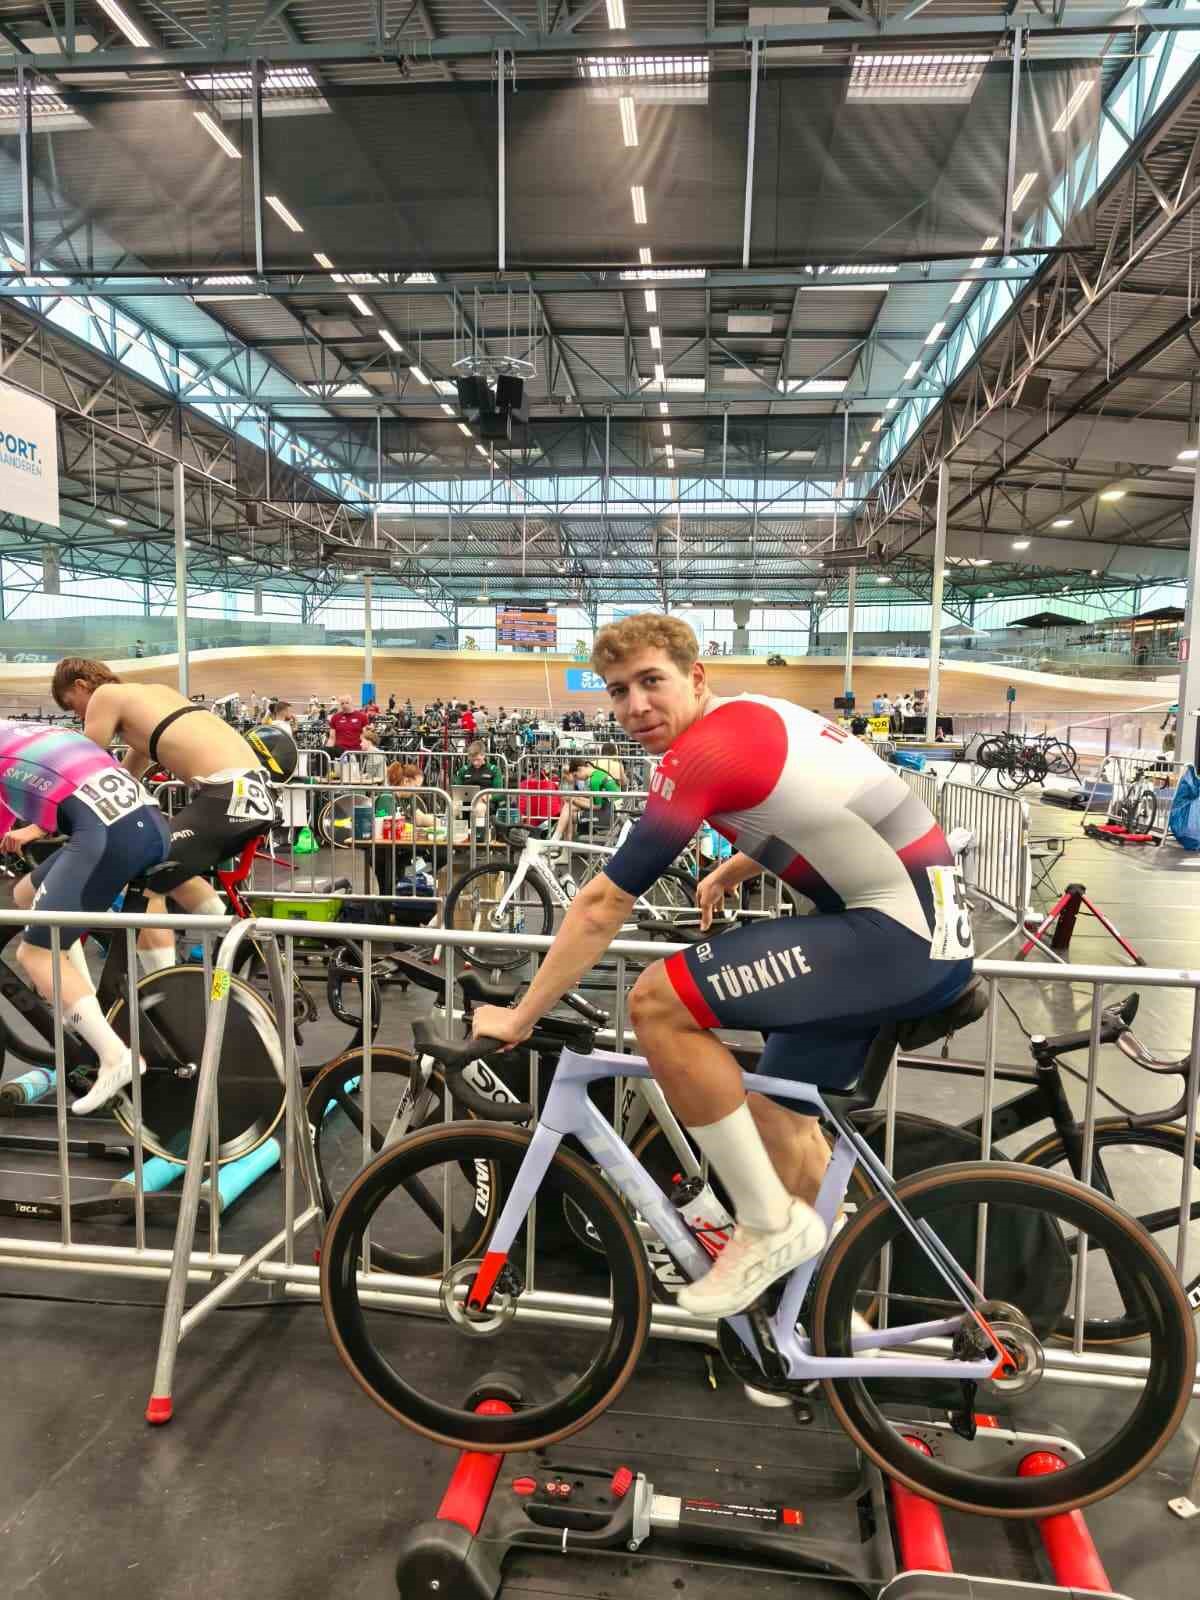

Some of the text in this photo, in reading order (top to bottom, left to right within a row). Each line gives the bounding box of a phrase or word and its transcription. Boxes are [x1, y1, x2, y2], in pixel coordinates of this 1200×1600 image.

[99, 774, 137, 809] 63
[245, 783, 270, 816] 62
[706, 945, 812, 1001] TÜRKİYE
